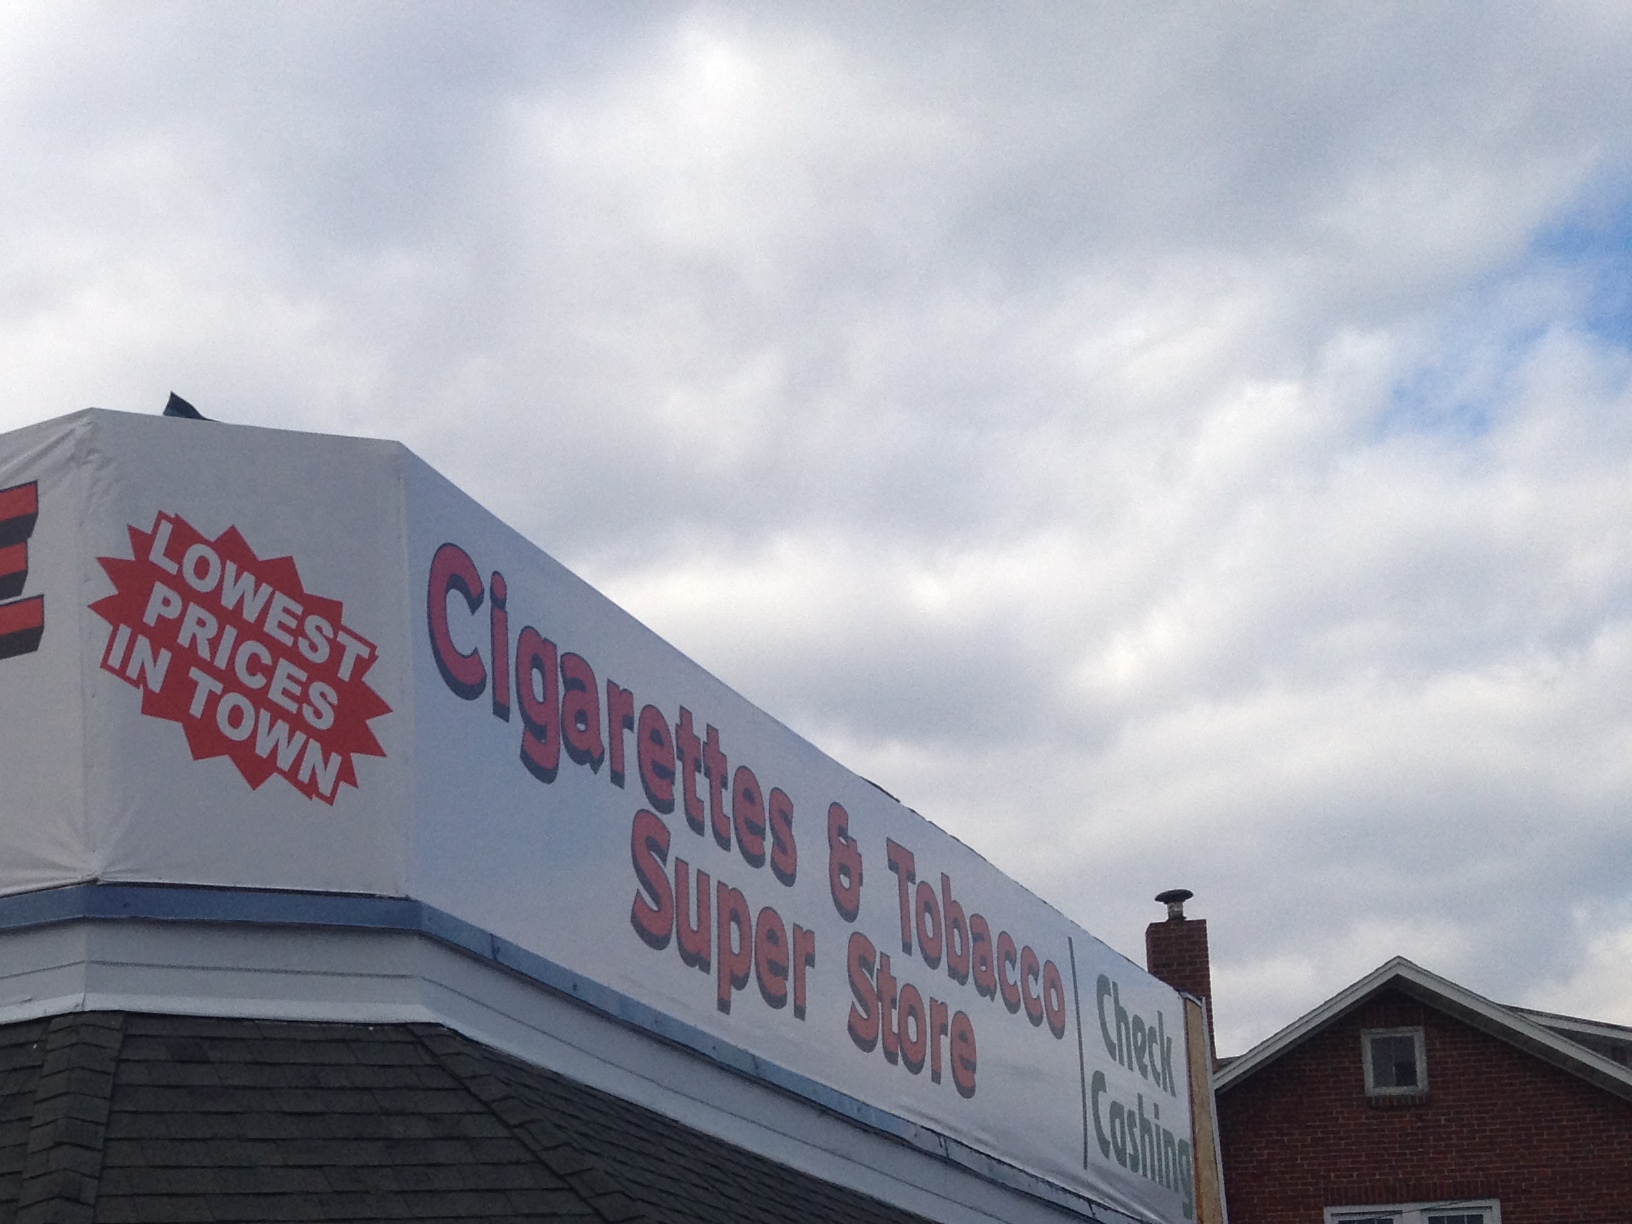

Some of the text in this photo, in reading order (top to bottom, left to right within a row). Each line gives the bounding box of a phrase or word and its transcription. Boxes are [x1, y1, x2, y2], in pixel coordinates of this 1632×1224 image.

[143, 582, 338, 731] PRICES
[149, 519, 372, 682] LOWEST
[109, 627, 343, 798] IN TOWN
[427, 543, 1067, 1041] Cigarettes & Tobacco
[630, 808, 978, 1099] Super Store
[1096, 973, 1176, 1097] Check
[1091, 1069, 1195, 1220] Cashing
